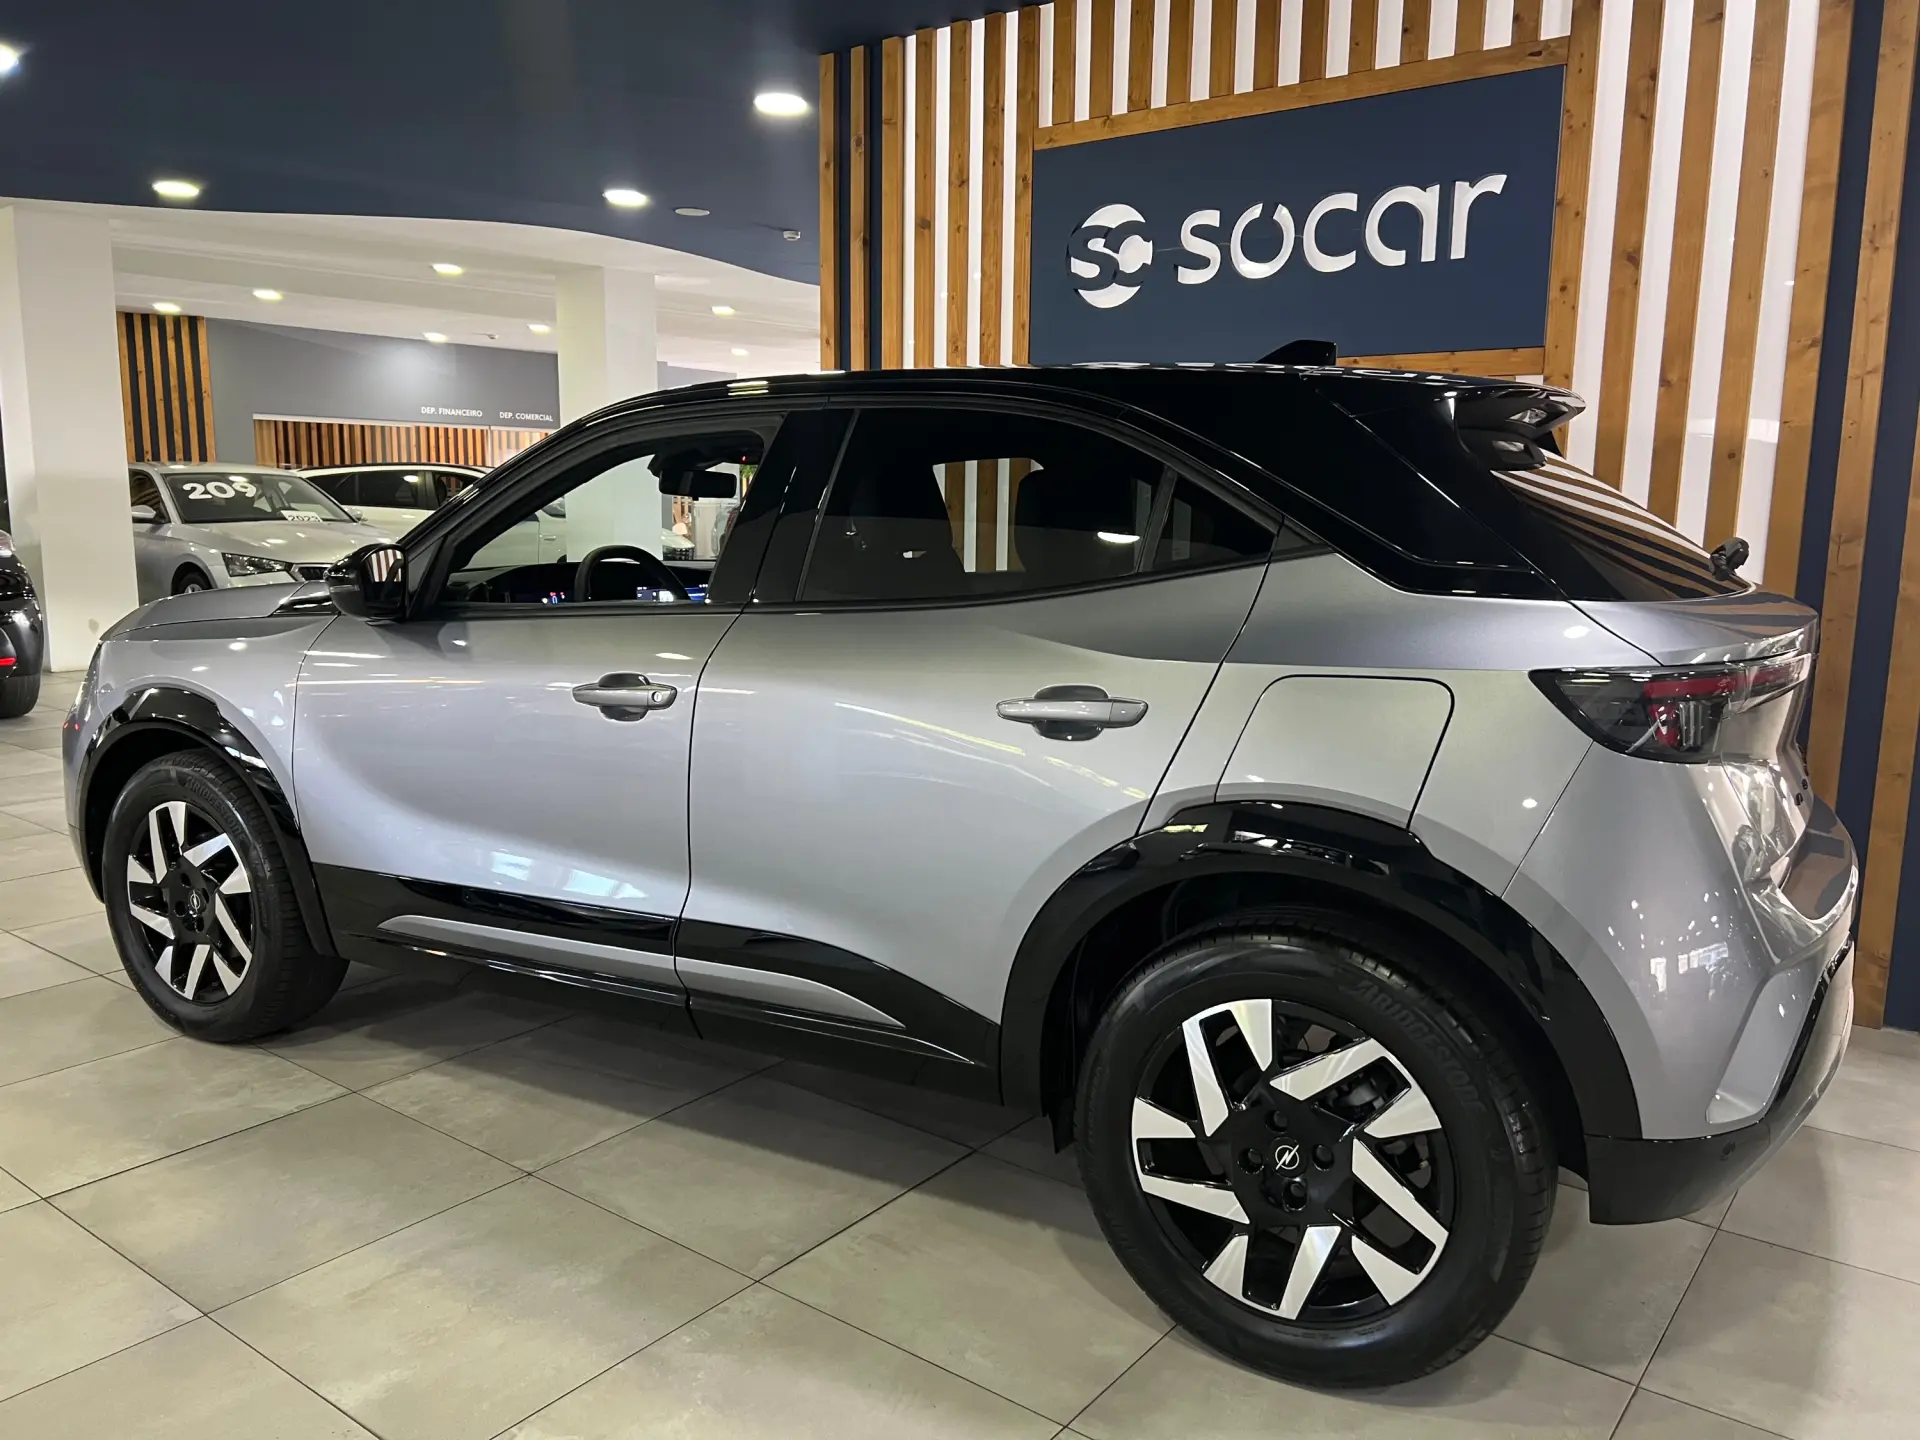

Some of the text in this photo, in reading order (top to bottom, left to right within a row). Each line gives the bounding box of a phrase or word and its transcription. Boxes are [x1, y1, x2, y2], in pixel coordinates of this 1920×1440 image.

[1174, 173, 1508, 285] socar
[421, 406, 483, 418] DEP. FINANCEIRO
[499, 411, 554, 422] DEP. COMERCIAL
[182, 481, 257, 500] 209
